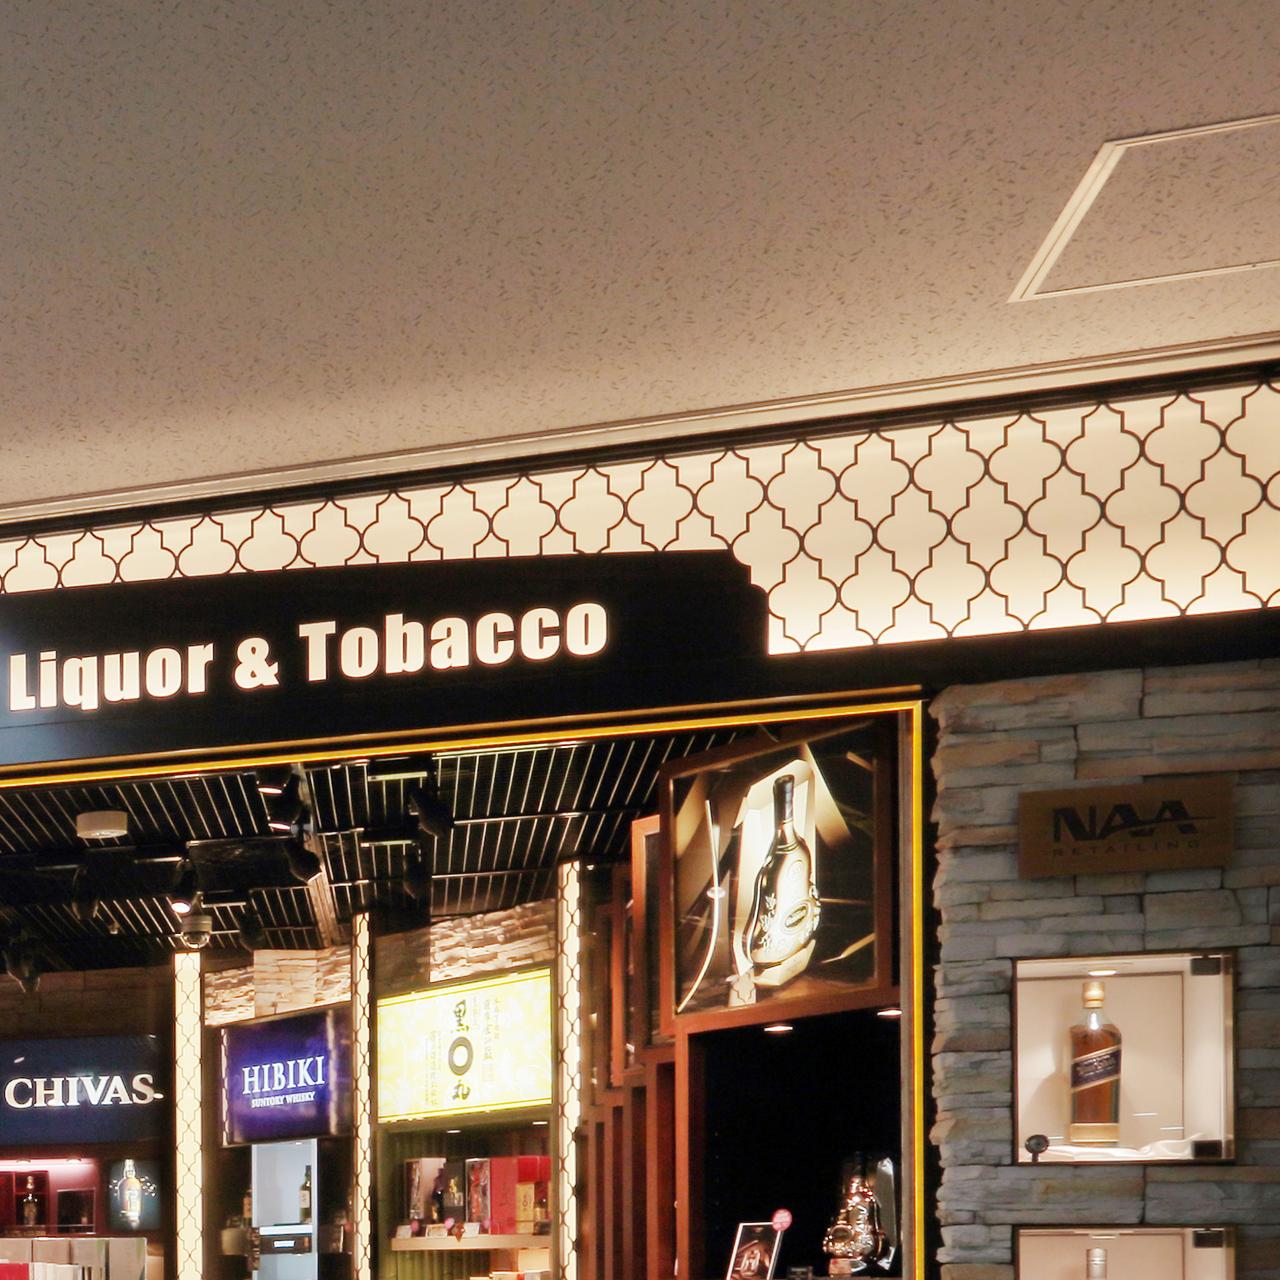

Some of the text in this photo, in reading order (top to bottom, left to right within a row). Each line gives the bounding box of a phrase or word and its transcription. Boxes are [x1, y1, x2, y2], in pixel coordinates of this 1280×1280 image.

[9, 642, 214, 712] Liquor
[234, 636, 280, 690] &
[299, 601, 608, 682] Tobacco
[1052, 800, 1208, 842] NAA
[5, 1073, 155, 1109] CHIVAS
[242, 1055, 325, 1095] HIBIKI
[251, 1091, 316, 1109] SUNTORY WHISKY
